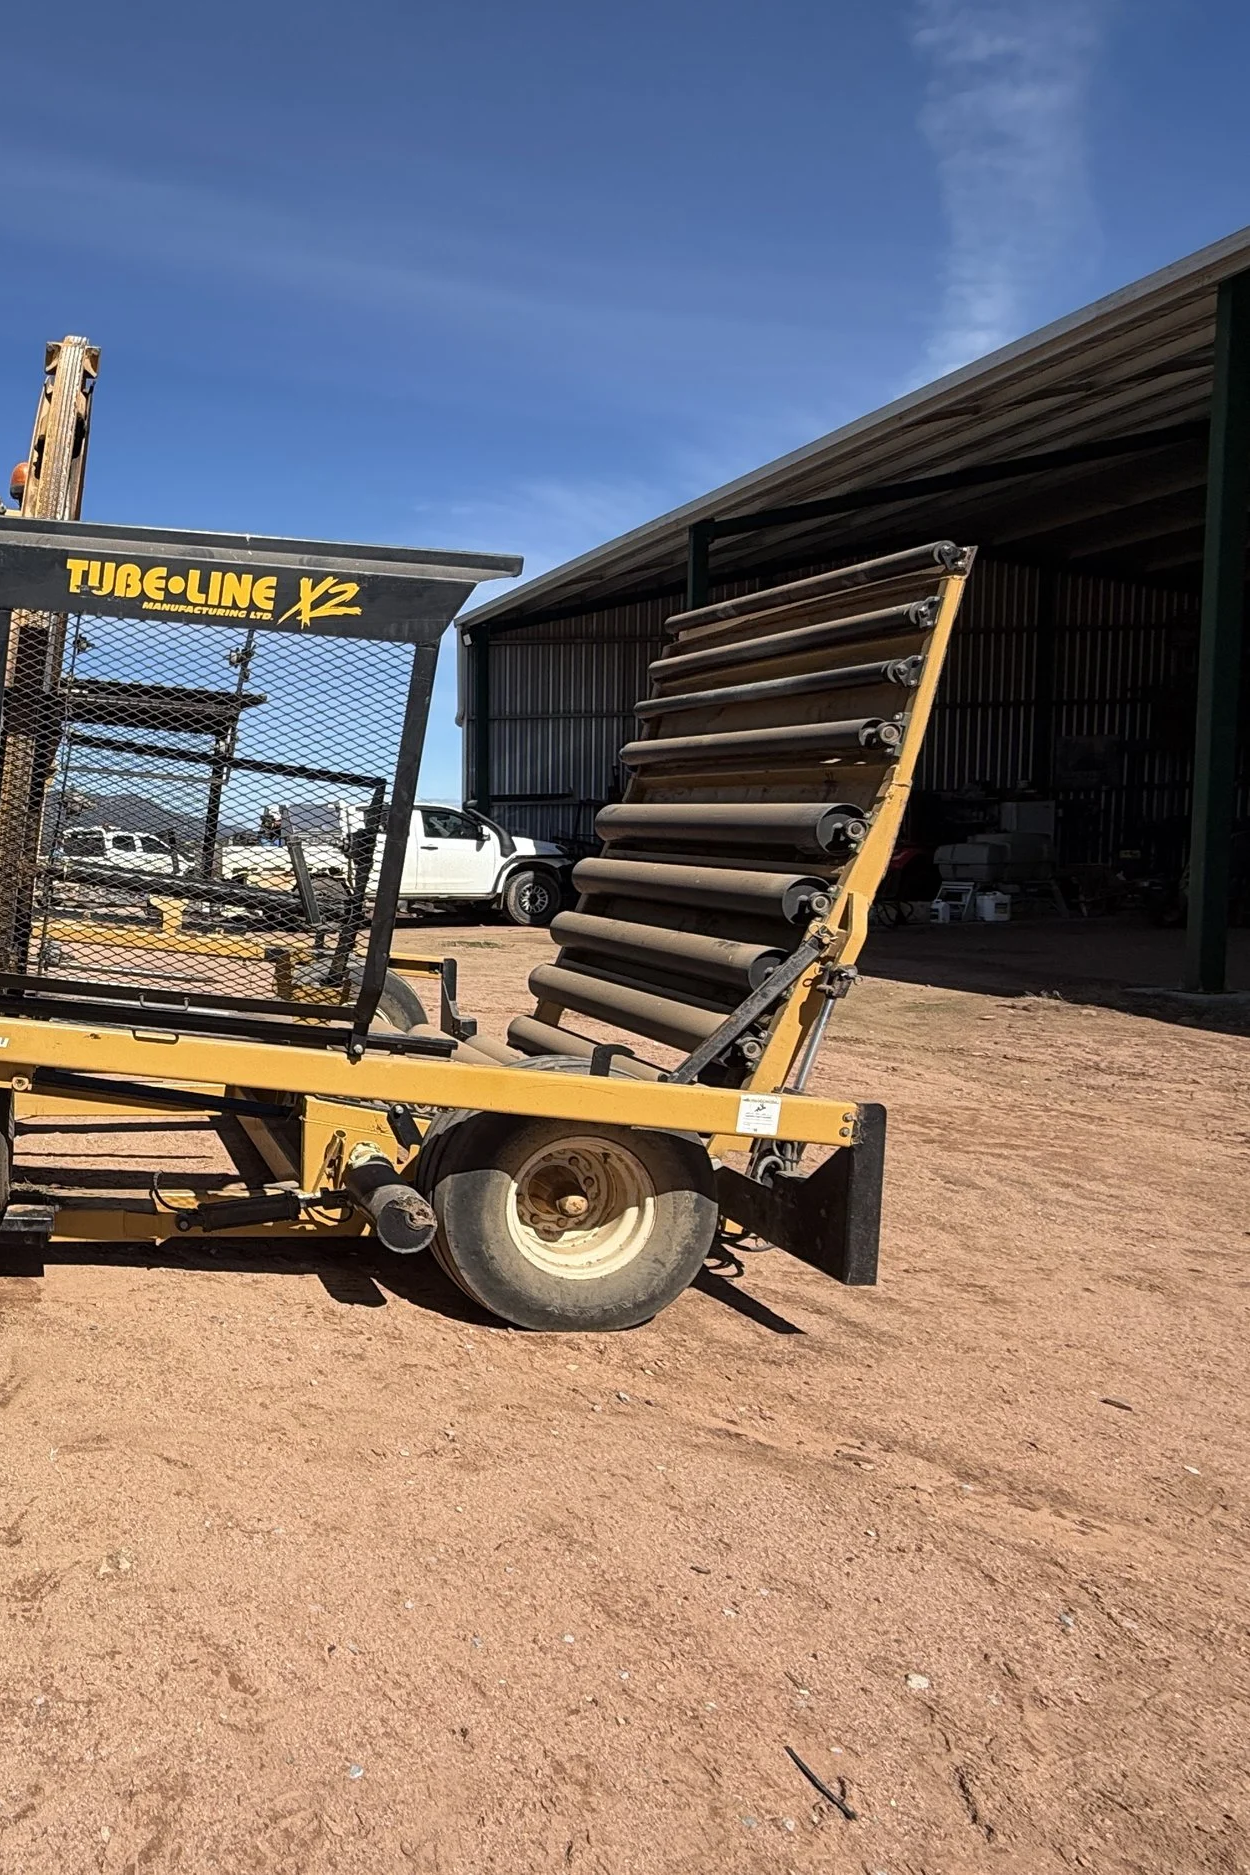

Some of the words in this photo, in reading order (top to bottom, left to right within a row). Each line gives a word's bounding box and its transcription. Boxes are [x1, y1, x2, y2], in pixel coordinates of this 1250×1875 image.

[142, 601, 248, 619] MANUFACTURING
[249, 611, 274, 621] LTD.
[276, 576, 362, 629] X2
